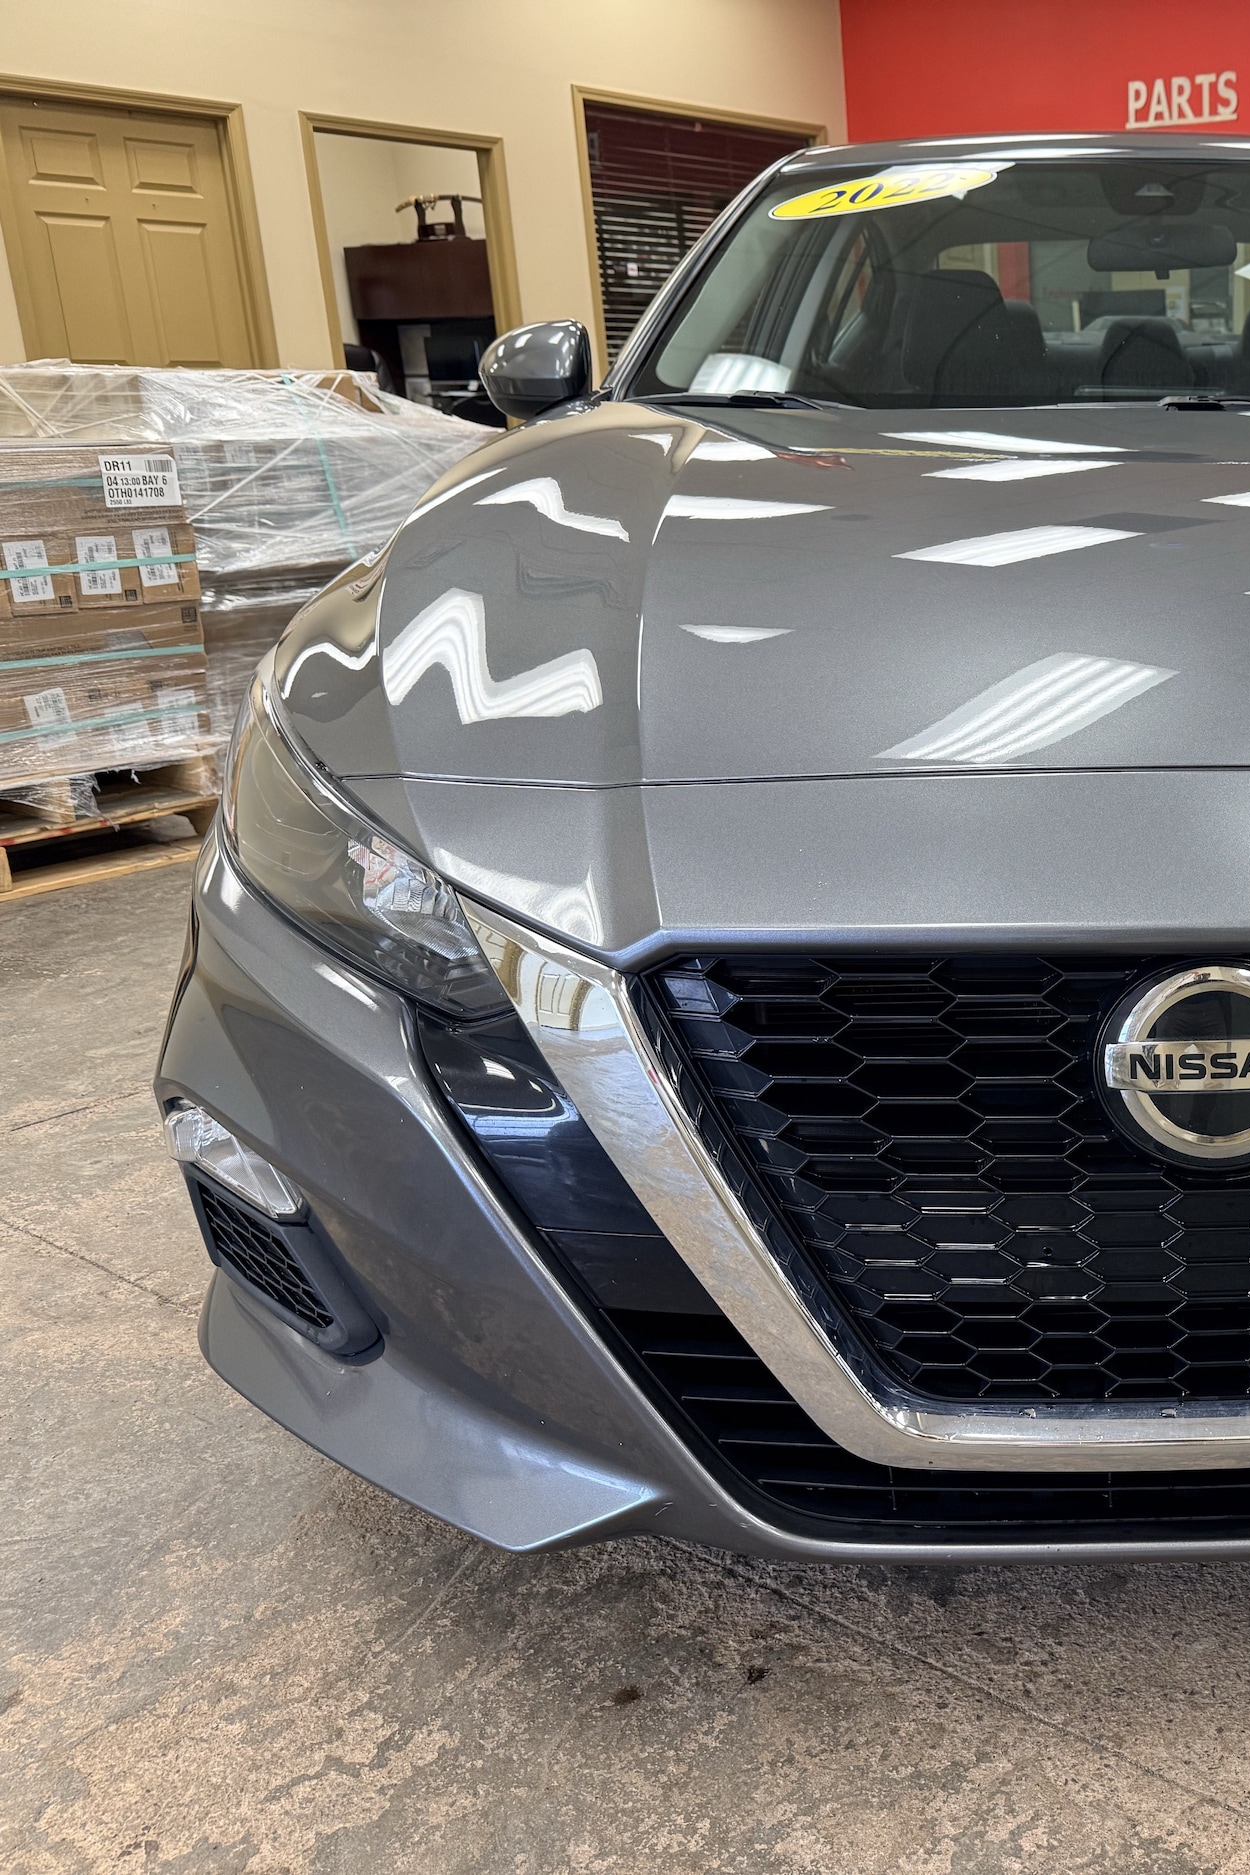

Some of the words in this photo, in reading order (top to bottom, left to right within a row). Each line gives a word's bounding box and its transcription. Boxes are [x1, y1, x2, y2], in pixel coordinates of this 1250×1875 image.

[1127, 71, 1238, 126] PARTS
[808, 172, 956, 214] 2022
[104, 460, 132, 472] DR11
[107, 475, 118, 487] 04
[120, 477, 141, 486] 13:00
[142, 475, 159, 486] BAY
[162, 474, 168, 486] 6
